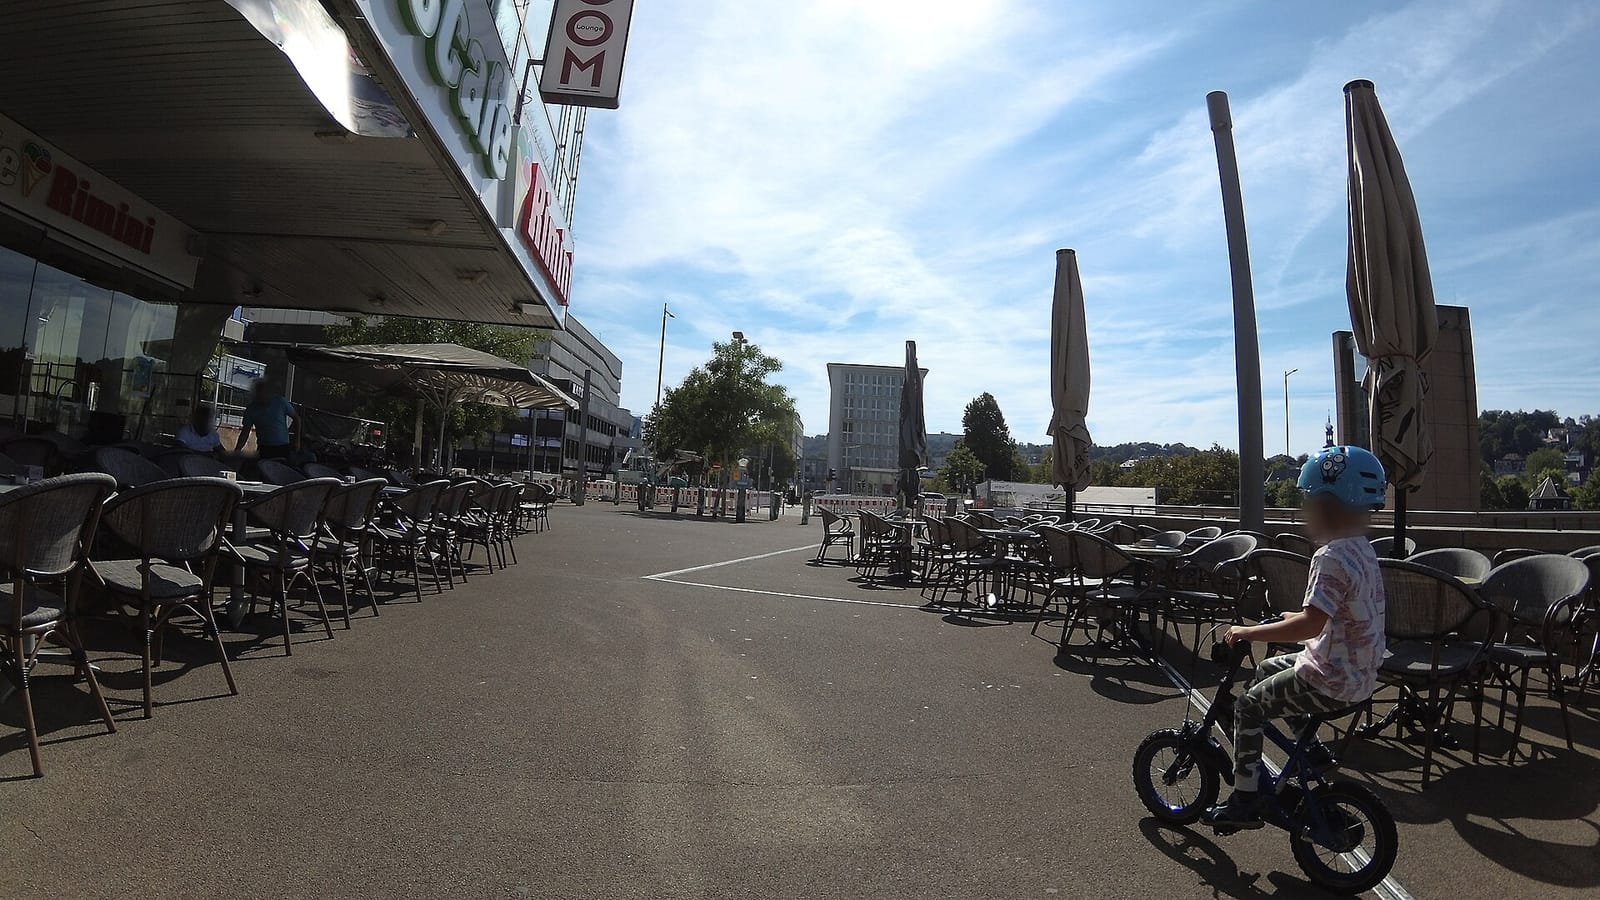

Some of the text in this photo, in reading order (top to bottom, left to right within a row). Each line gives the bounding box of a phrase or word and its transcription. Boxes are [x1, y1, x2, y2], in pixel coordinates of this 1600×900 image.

[560, 0, 614, 88] OM
[576, 24, 604, 32] Lounge
[47, 164, 157, 256] Rimini
[520, 161, 573, 306] Rimini
